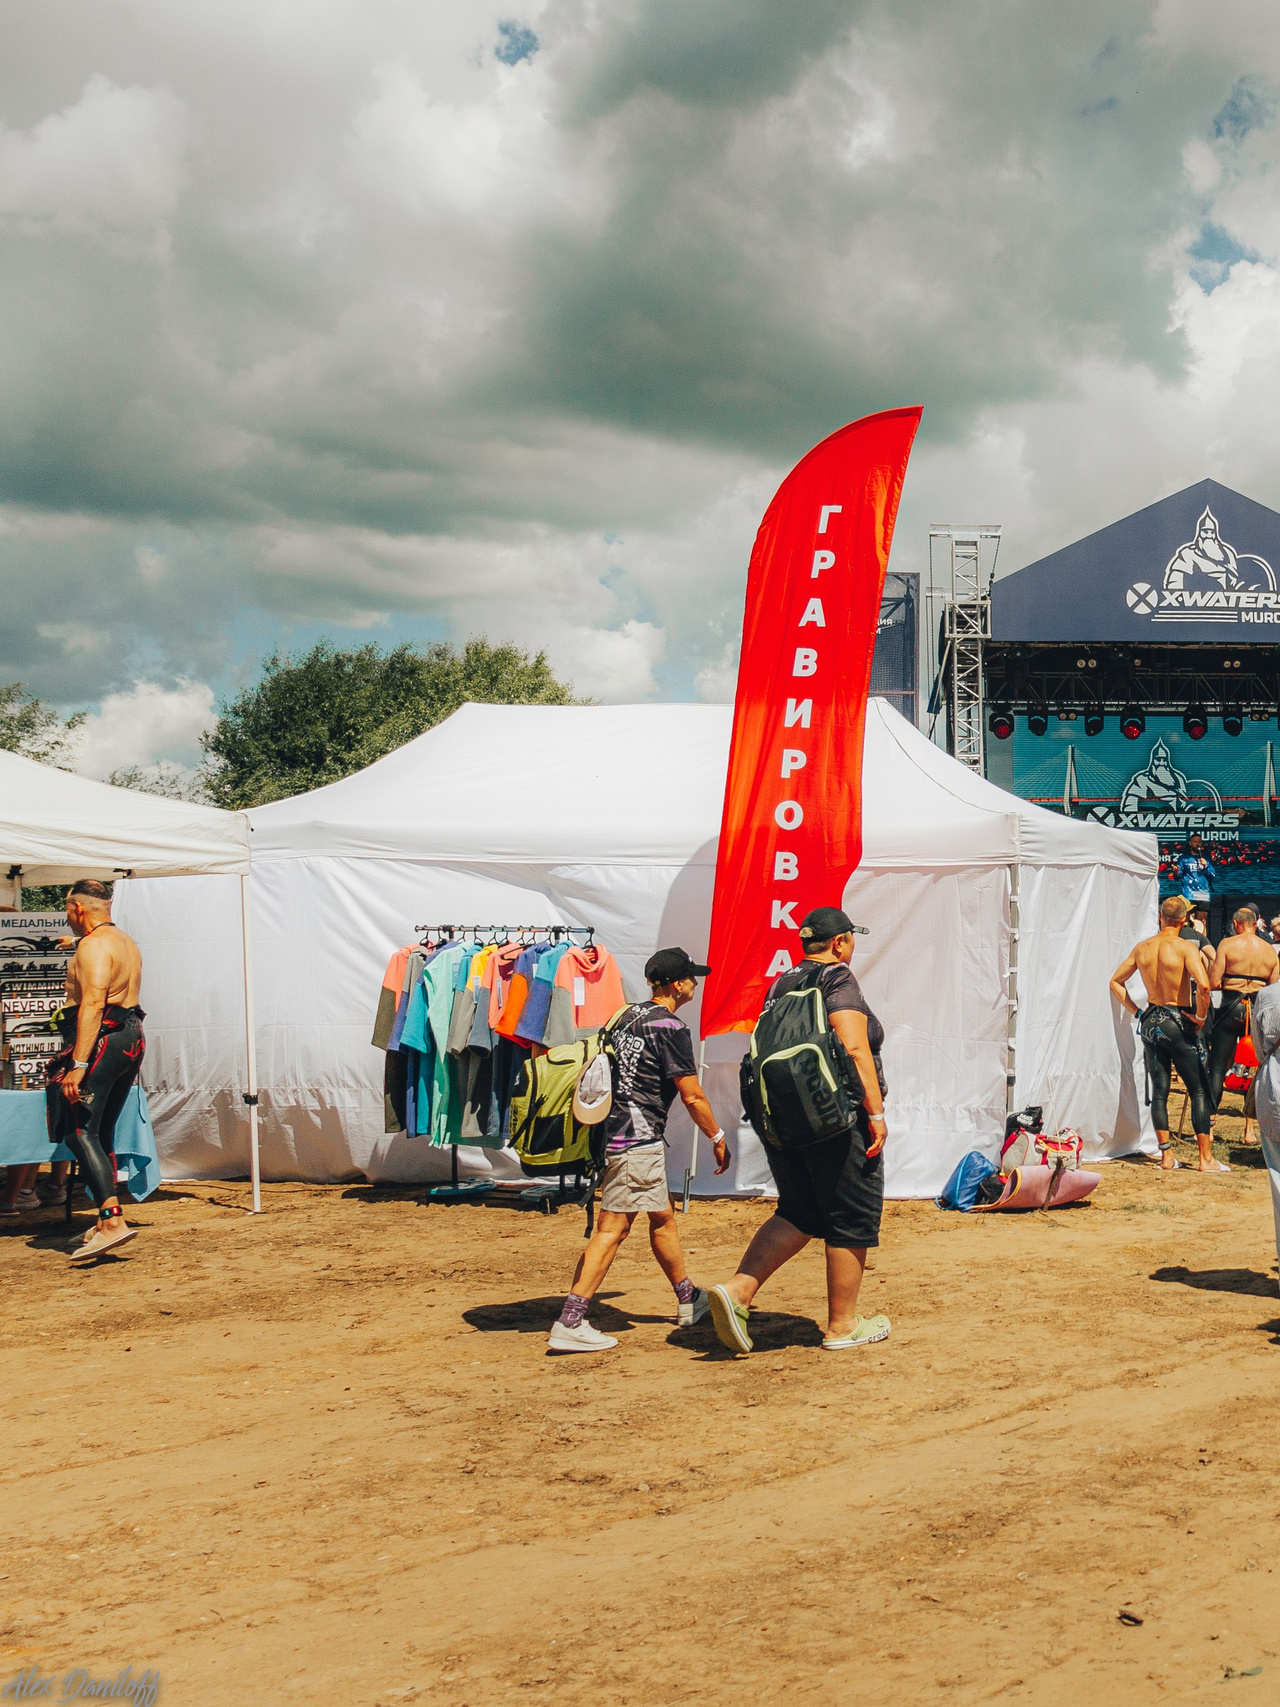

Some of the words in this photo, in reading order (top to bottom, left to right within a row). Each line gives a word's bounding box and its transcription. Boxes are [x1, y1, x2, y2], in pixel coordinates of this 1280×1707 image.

[765, 505, 842, 976] ГРАВИРОВКА
[3, 1001, 44, 1011] NEVER
[12, 1043, 45, 1053] NOTHING
[48, 1043, 55, 1051] IS
